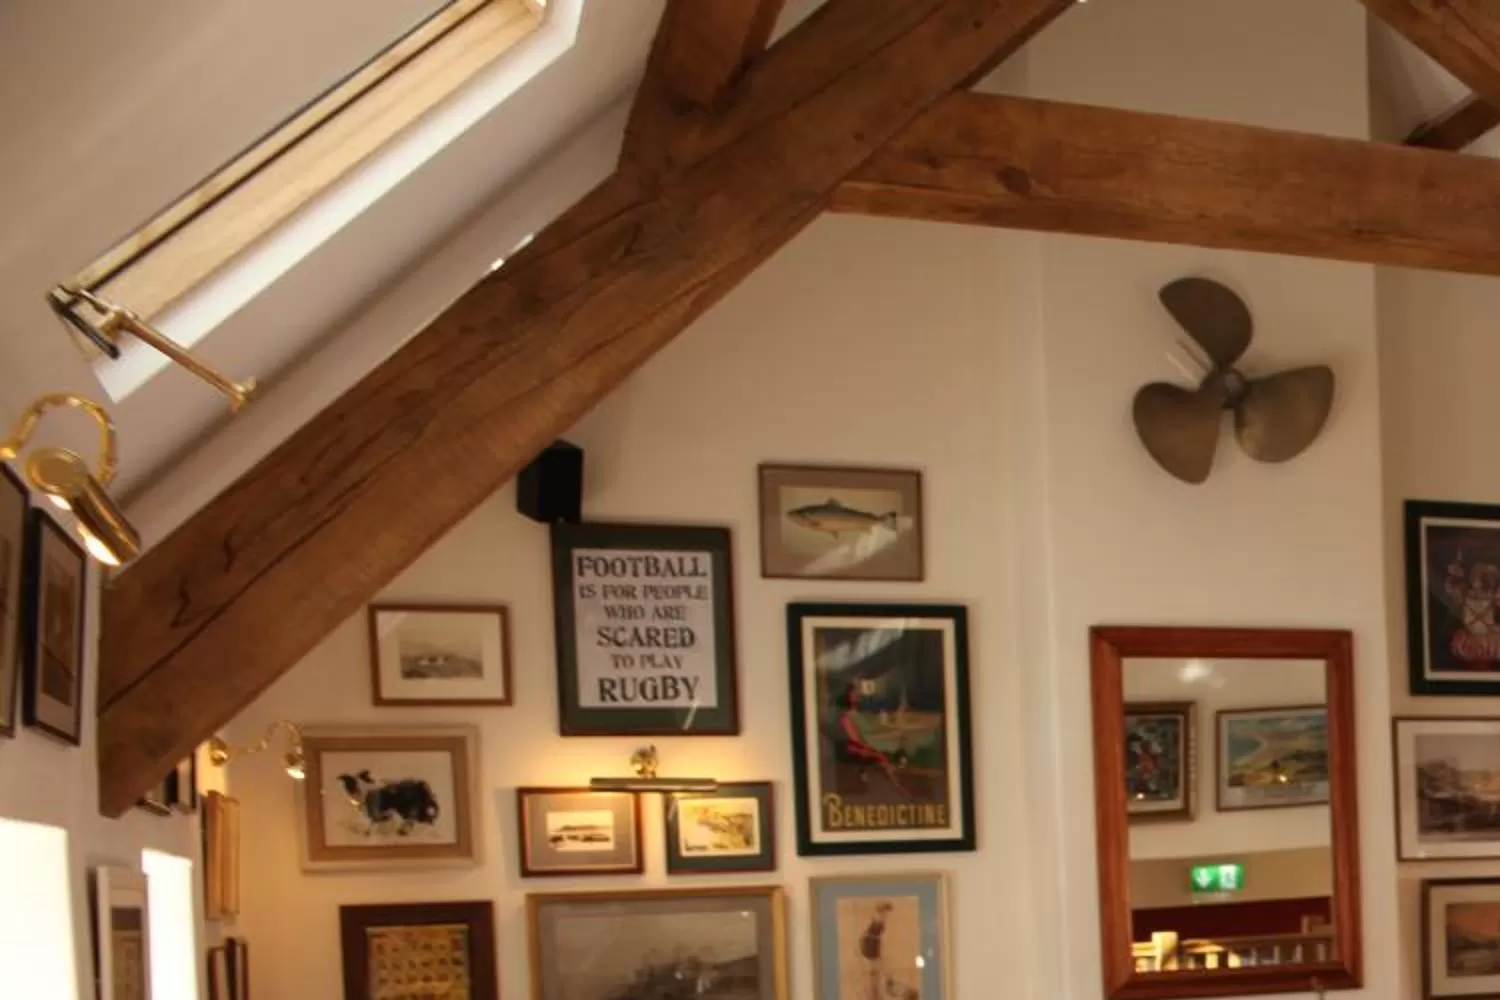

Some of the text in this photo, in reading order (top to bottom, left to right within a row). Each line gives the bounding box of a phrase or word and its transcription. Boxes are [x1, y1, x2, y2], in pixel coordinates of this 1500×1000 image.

[577, 556, 707, 577] FOOTBALL
[579, 584, 708, 600] IS FOR PEOPLE
[604, 605, 686, 621] WHO ARE
[596, 626, 696, 648] SCARED
[611, 654, 684, 669] TO PLAY
[598, 676, 700, 702] RUGBY
